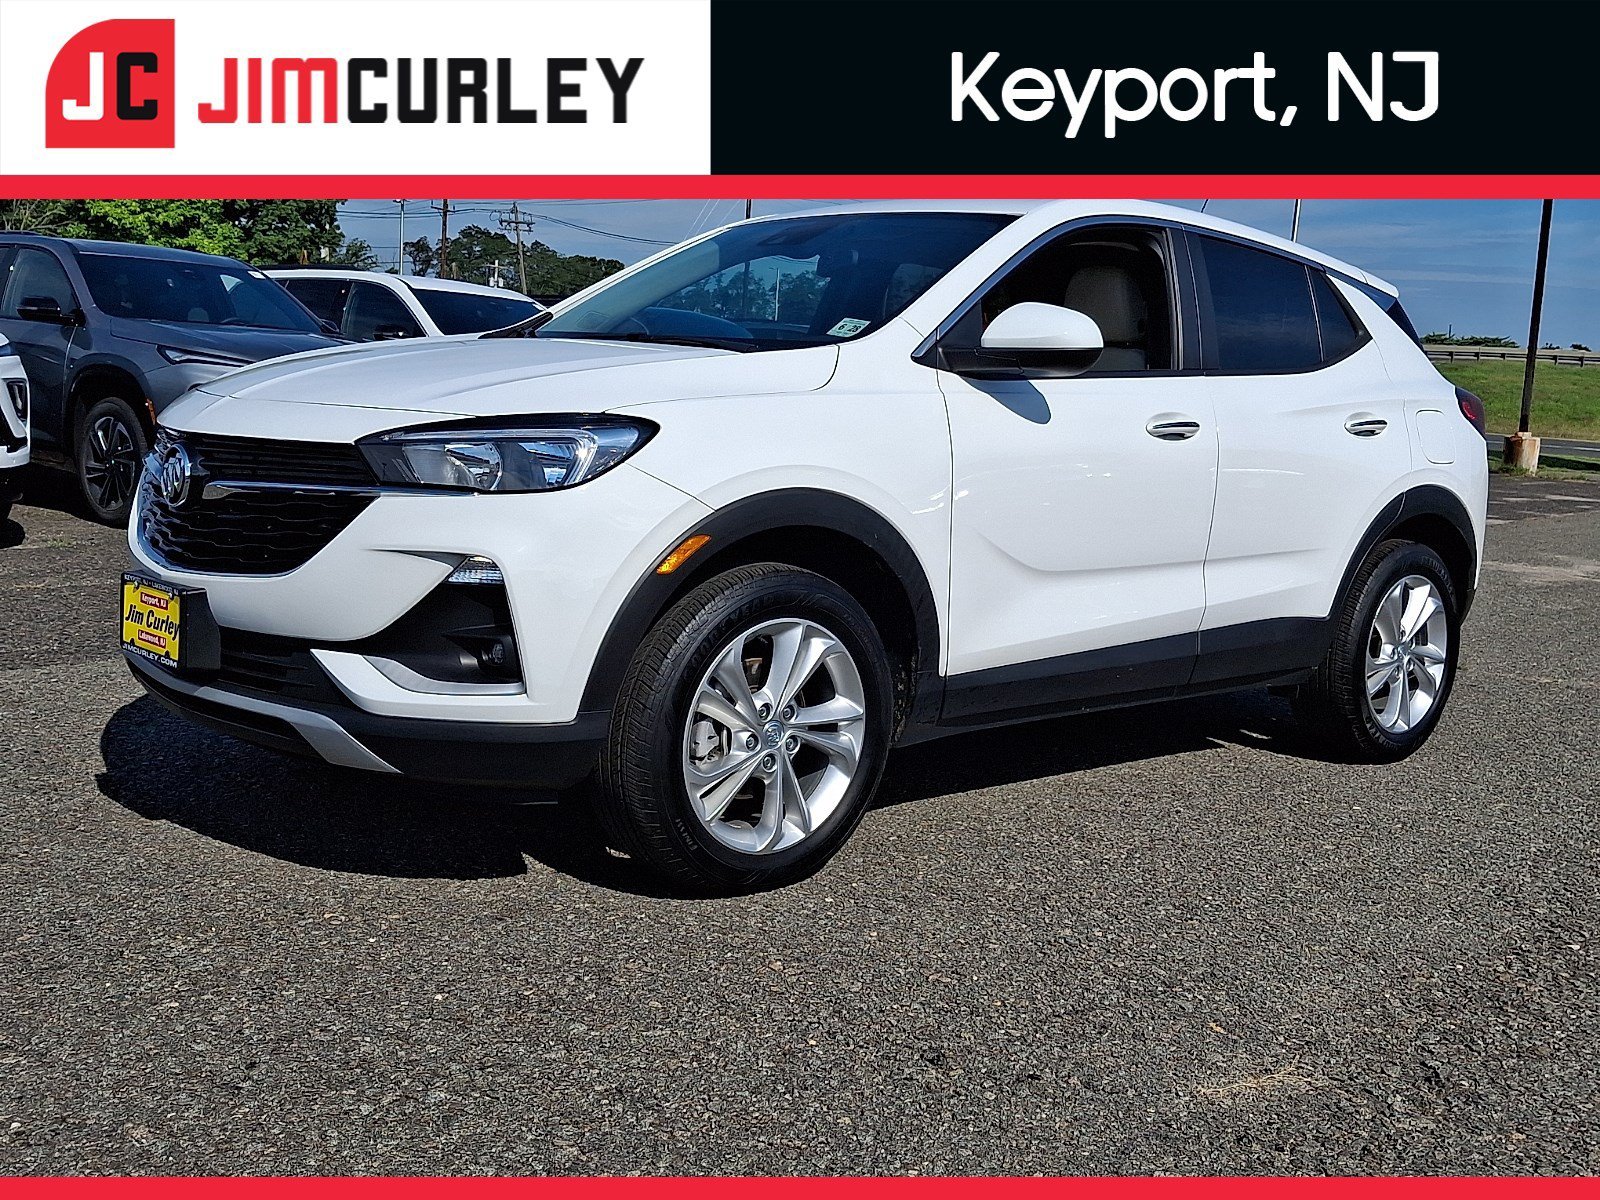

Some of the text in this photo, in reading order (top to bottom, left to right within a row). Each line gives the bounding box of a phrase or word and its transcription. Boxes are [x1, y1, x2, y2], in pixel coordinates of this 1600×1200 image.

[125, 603, 180, 641] Jim Curley
[122, 643, 178, 668] JIMCURLEY.COM
